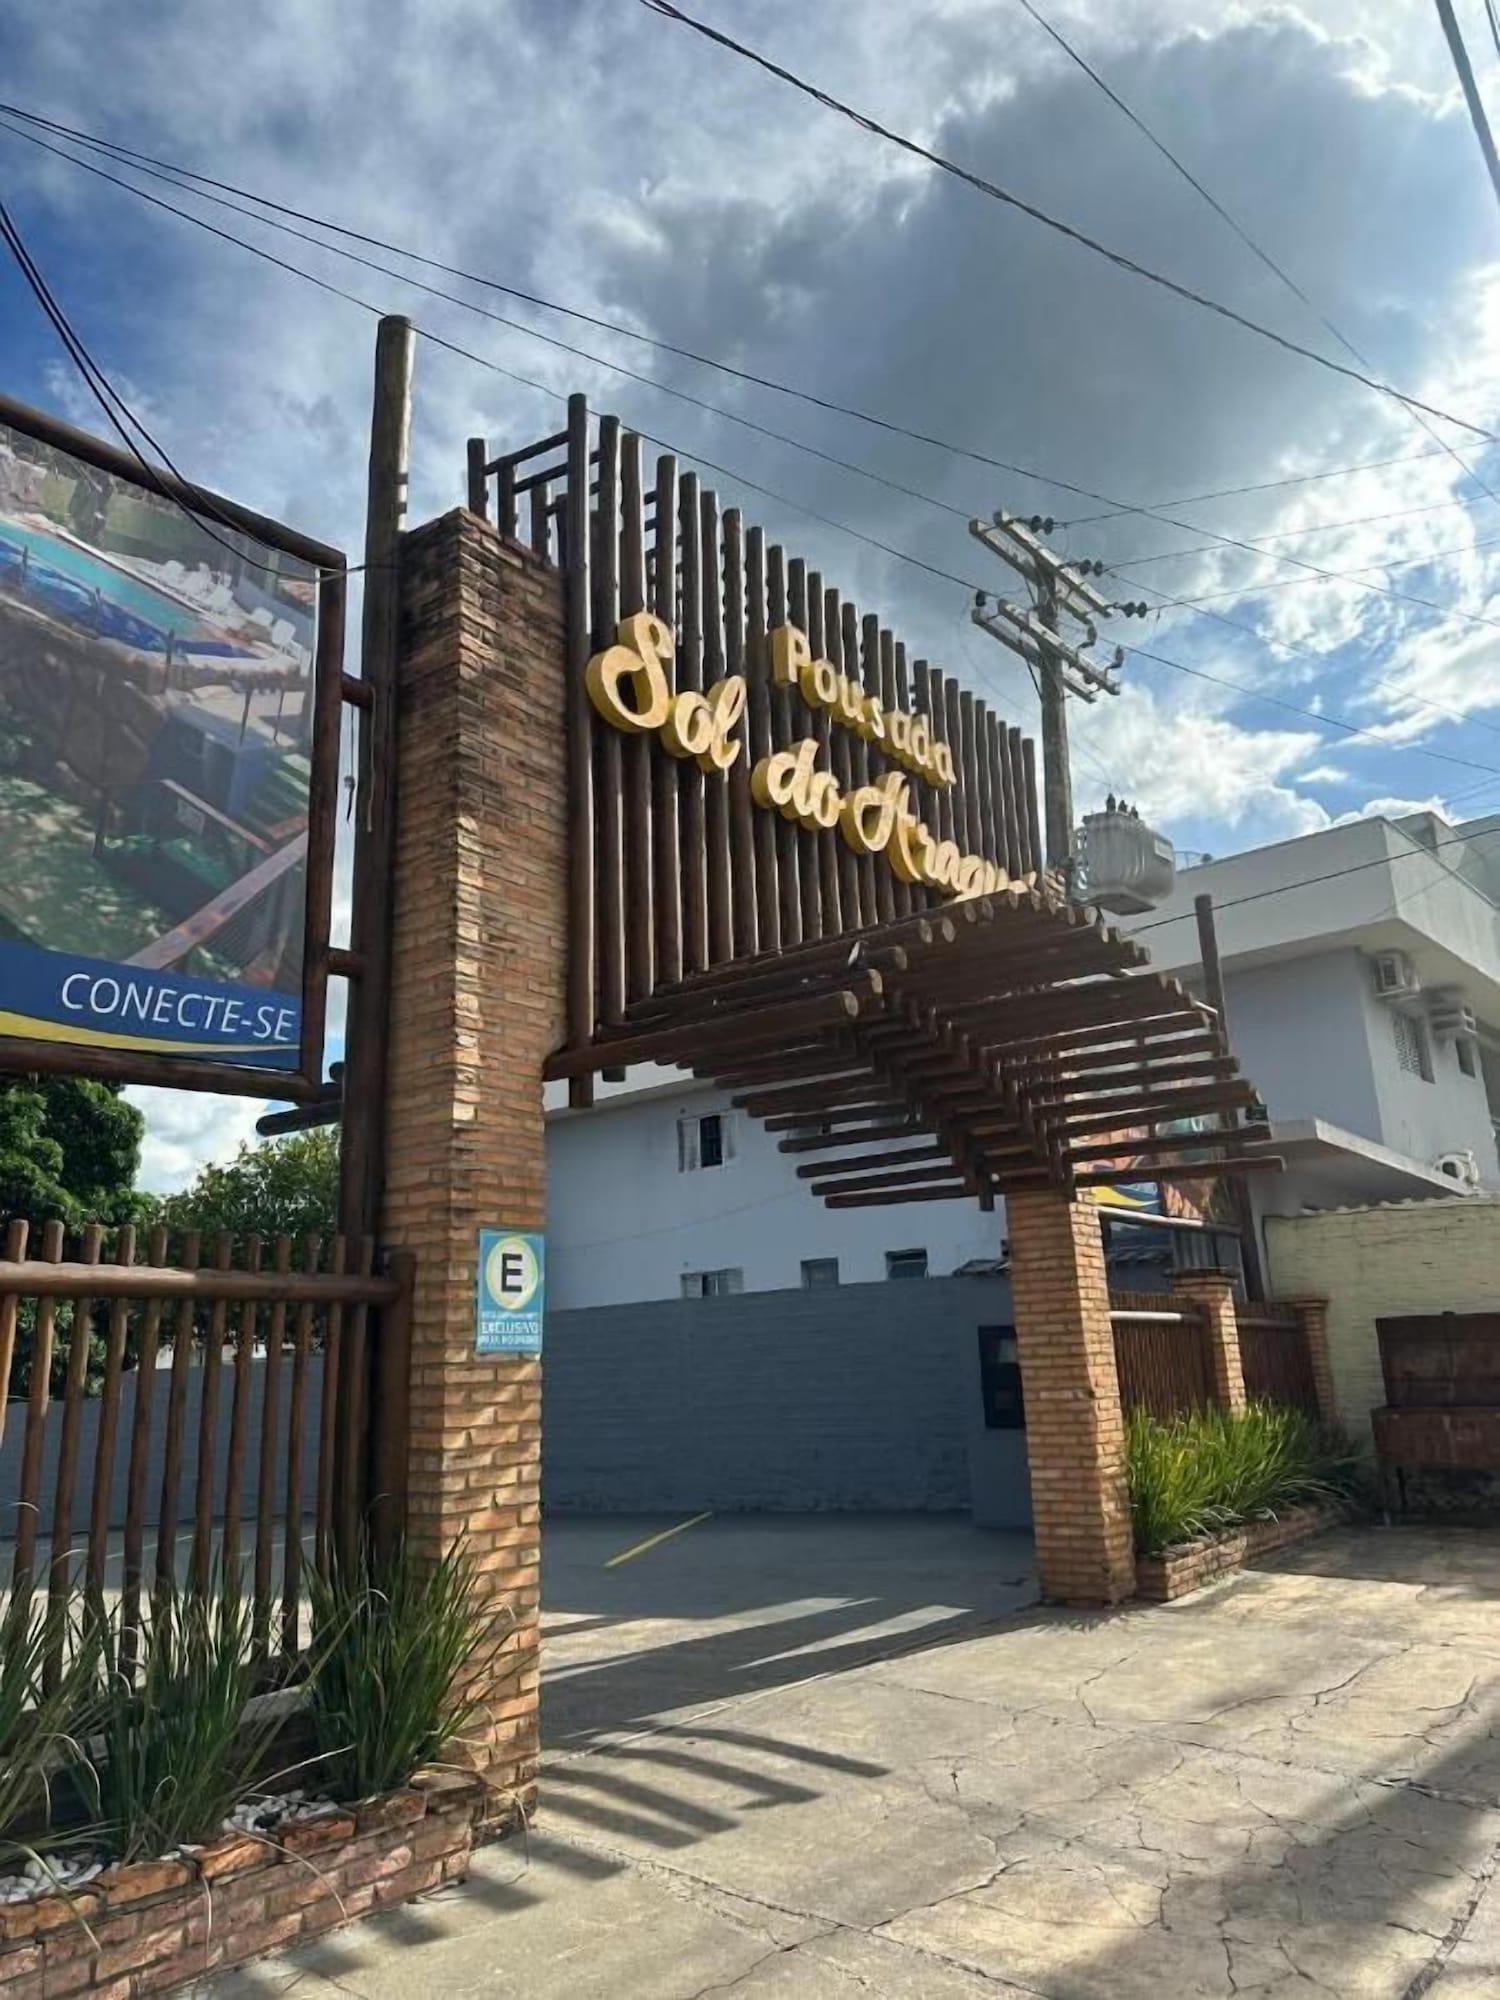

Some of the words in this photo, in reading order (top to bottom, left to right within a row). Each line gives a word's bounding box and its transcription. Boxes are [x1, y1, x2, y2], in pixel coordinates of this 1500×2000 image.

[586, 612, 746, 771] Sol
[751, 737, 846, 831] do
[772, 625, 956, 785] Pousada
[61, 973, 296, 1041] CONECTE-SE
[501, 1253, 523, 1292] E
